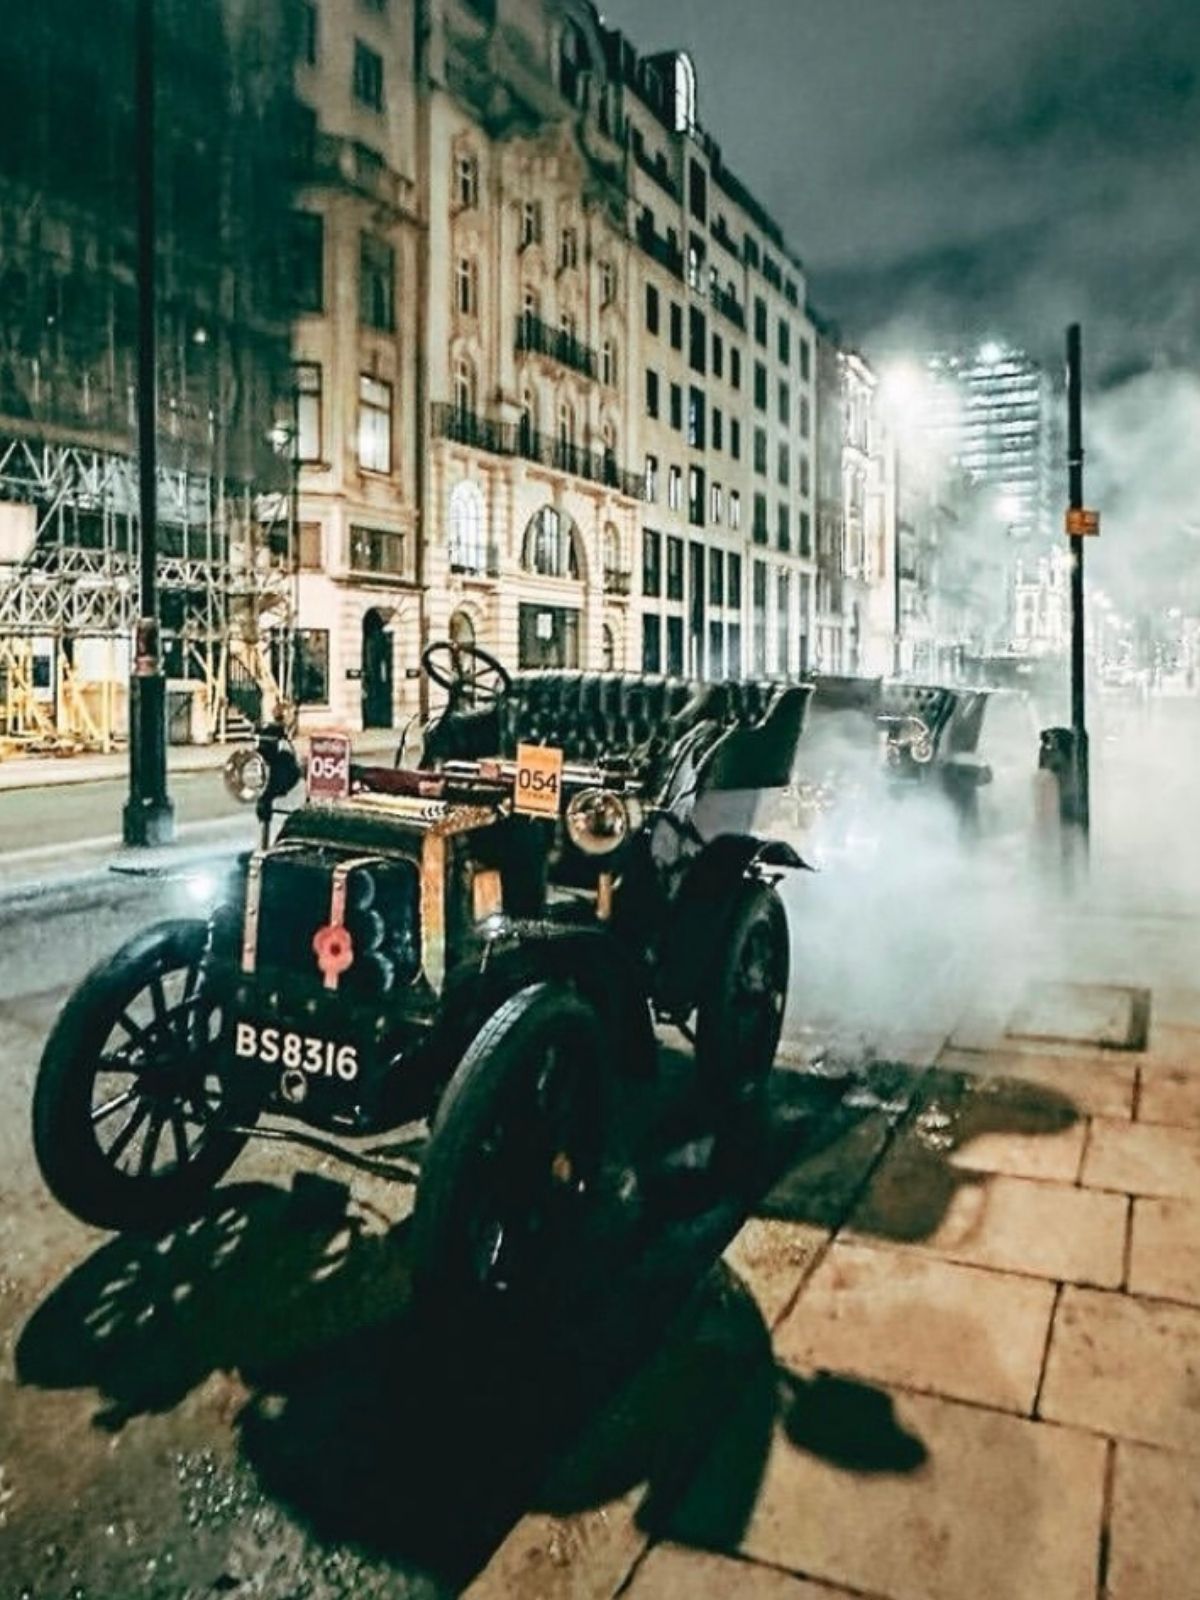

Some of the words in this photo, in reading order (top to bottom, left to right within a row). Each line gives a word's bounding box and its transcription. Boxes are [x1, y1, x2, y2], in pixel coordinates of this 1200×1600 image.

[312, 756, 346, 779] 054
[519, 768, 557, 793] 054
[236, 1021, 358, 1081] BS8316
